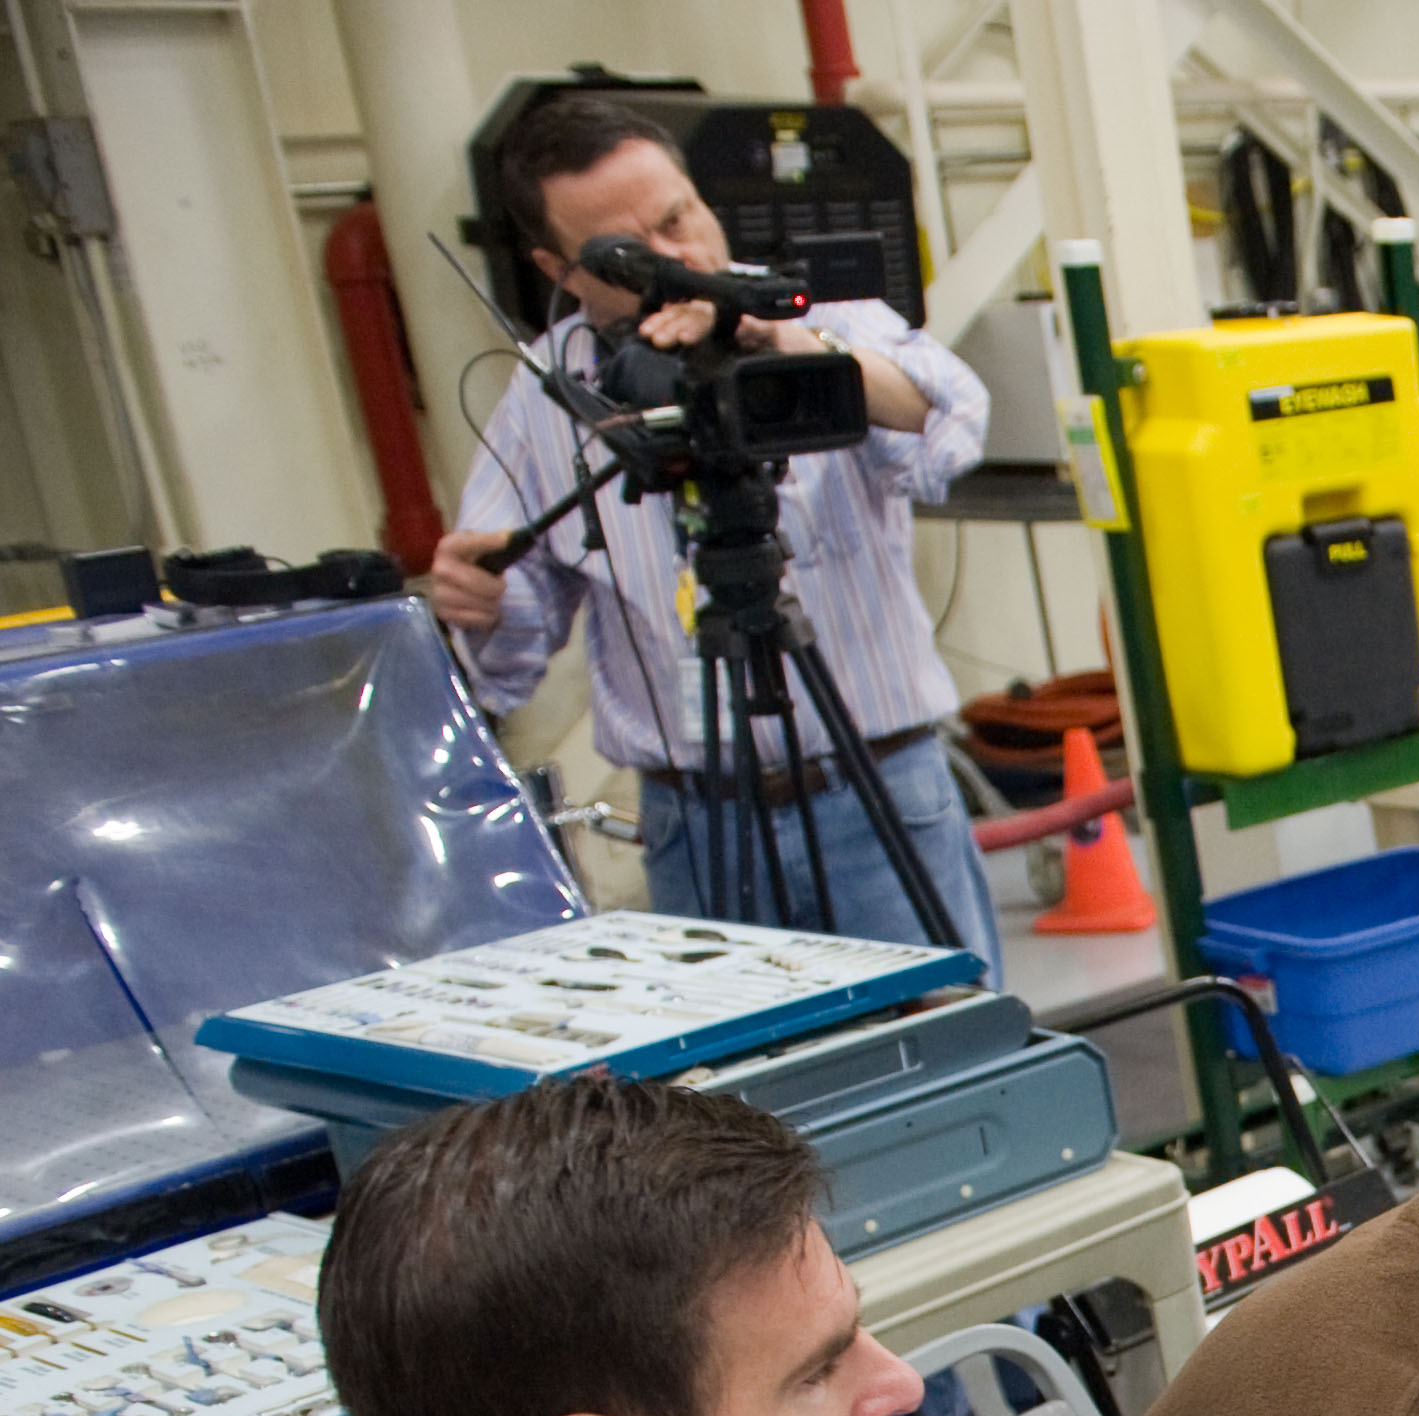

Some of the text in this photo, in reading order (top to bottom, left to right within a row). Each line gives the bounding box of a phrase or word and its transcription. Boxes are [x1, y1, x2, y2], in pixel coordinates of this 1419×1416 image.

[1280, 381, 1370, 416] EYEWASH
[1328, 540, 1367, 563] PULL
[1196, 1197, 1339, 1292] YPALL
